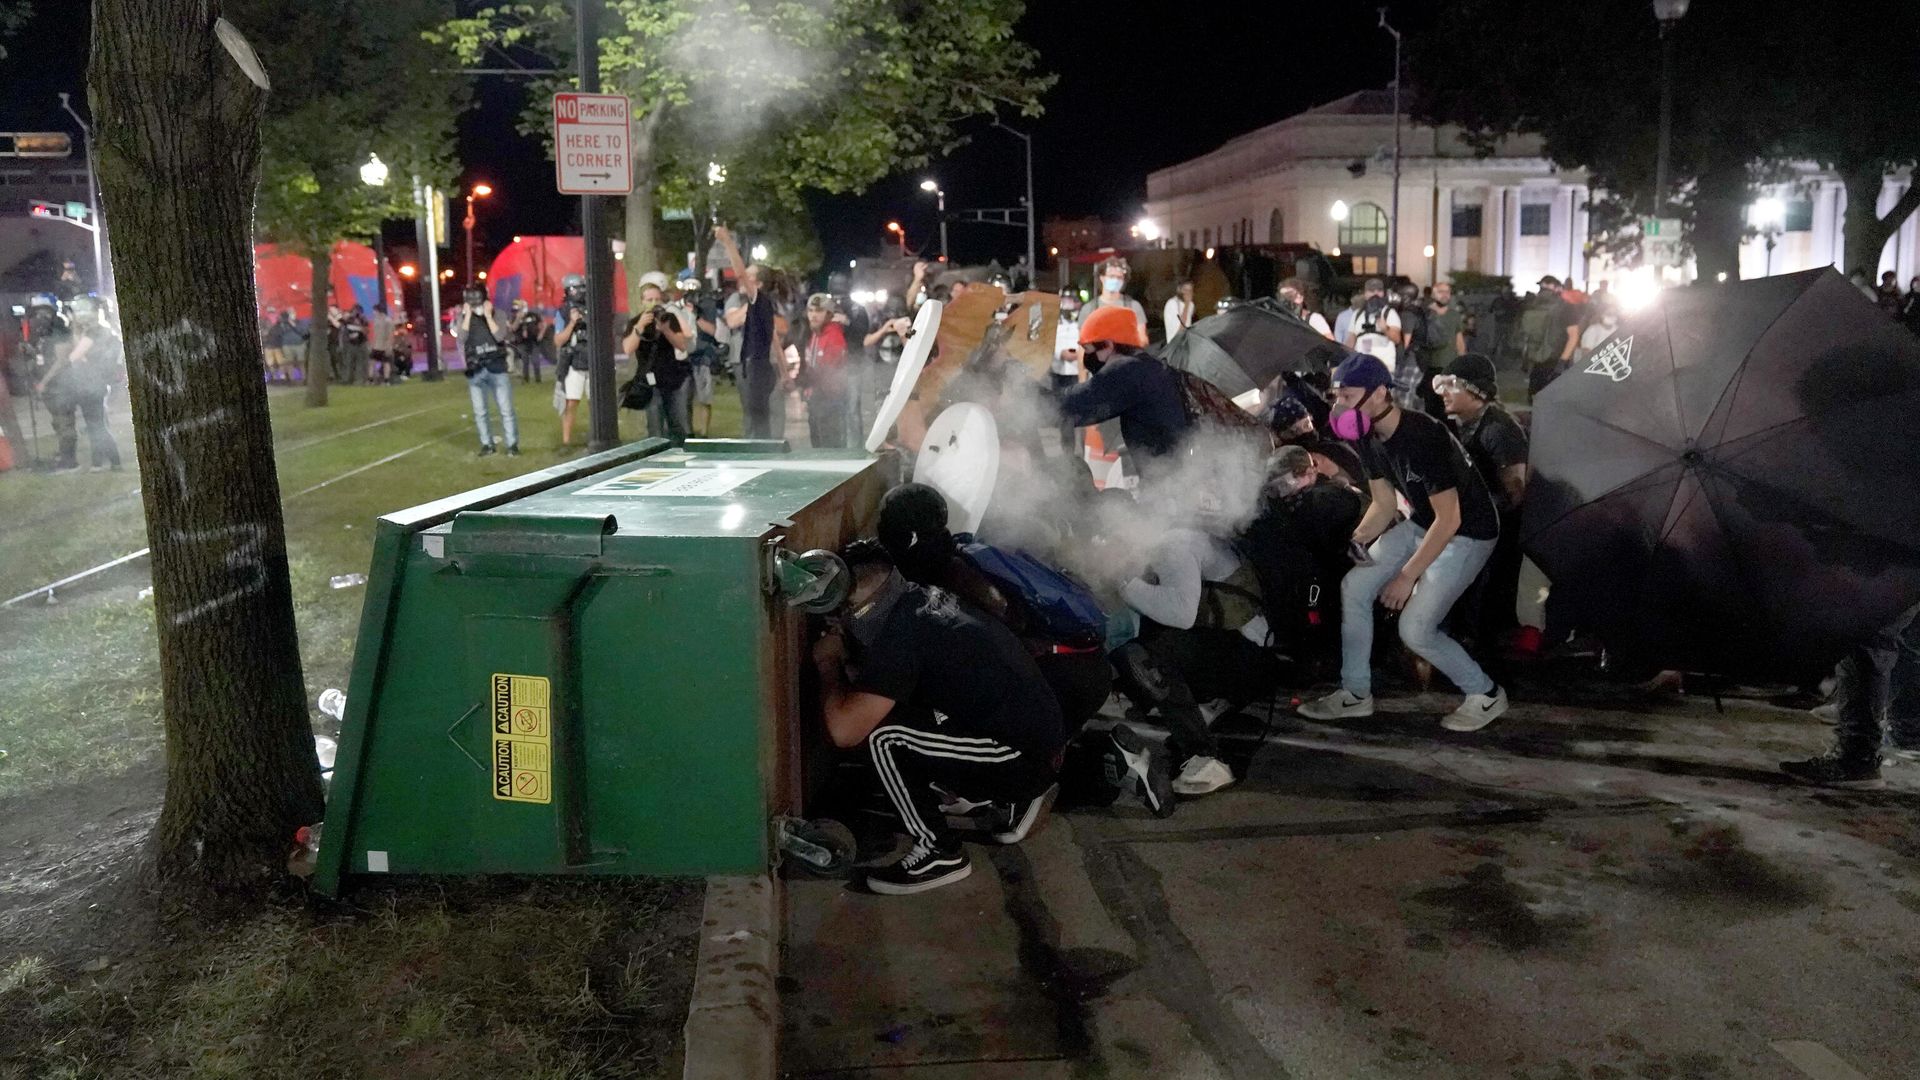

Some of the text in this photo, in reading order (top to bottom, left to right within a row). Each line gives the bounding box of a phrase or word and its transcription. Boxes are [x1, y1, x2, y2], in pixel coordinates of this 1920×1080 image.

[557, 99, 625, 119] NO PARKING
[566, 134, 622, 149] HERE TO
[567, 153, 622, 168] CORNER
[496, 676, 509, 722] CAUTION
[498, 740, 510, 785] CAUTION
